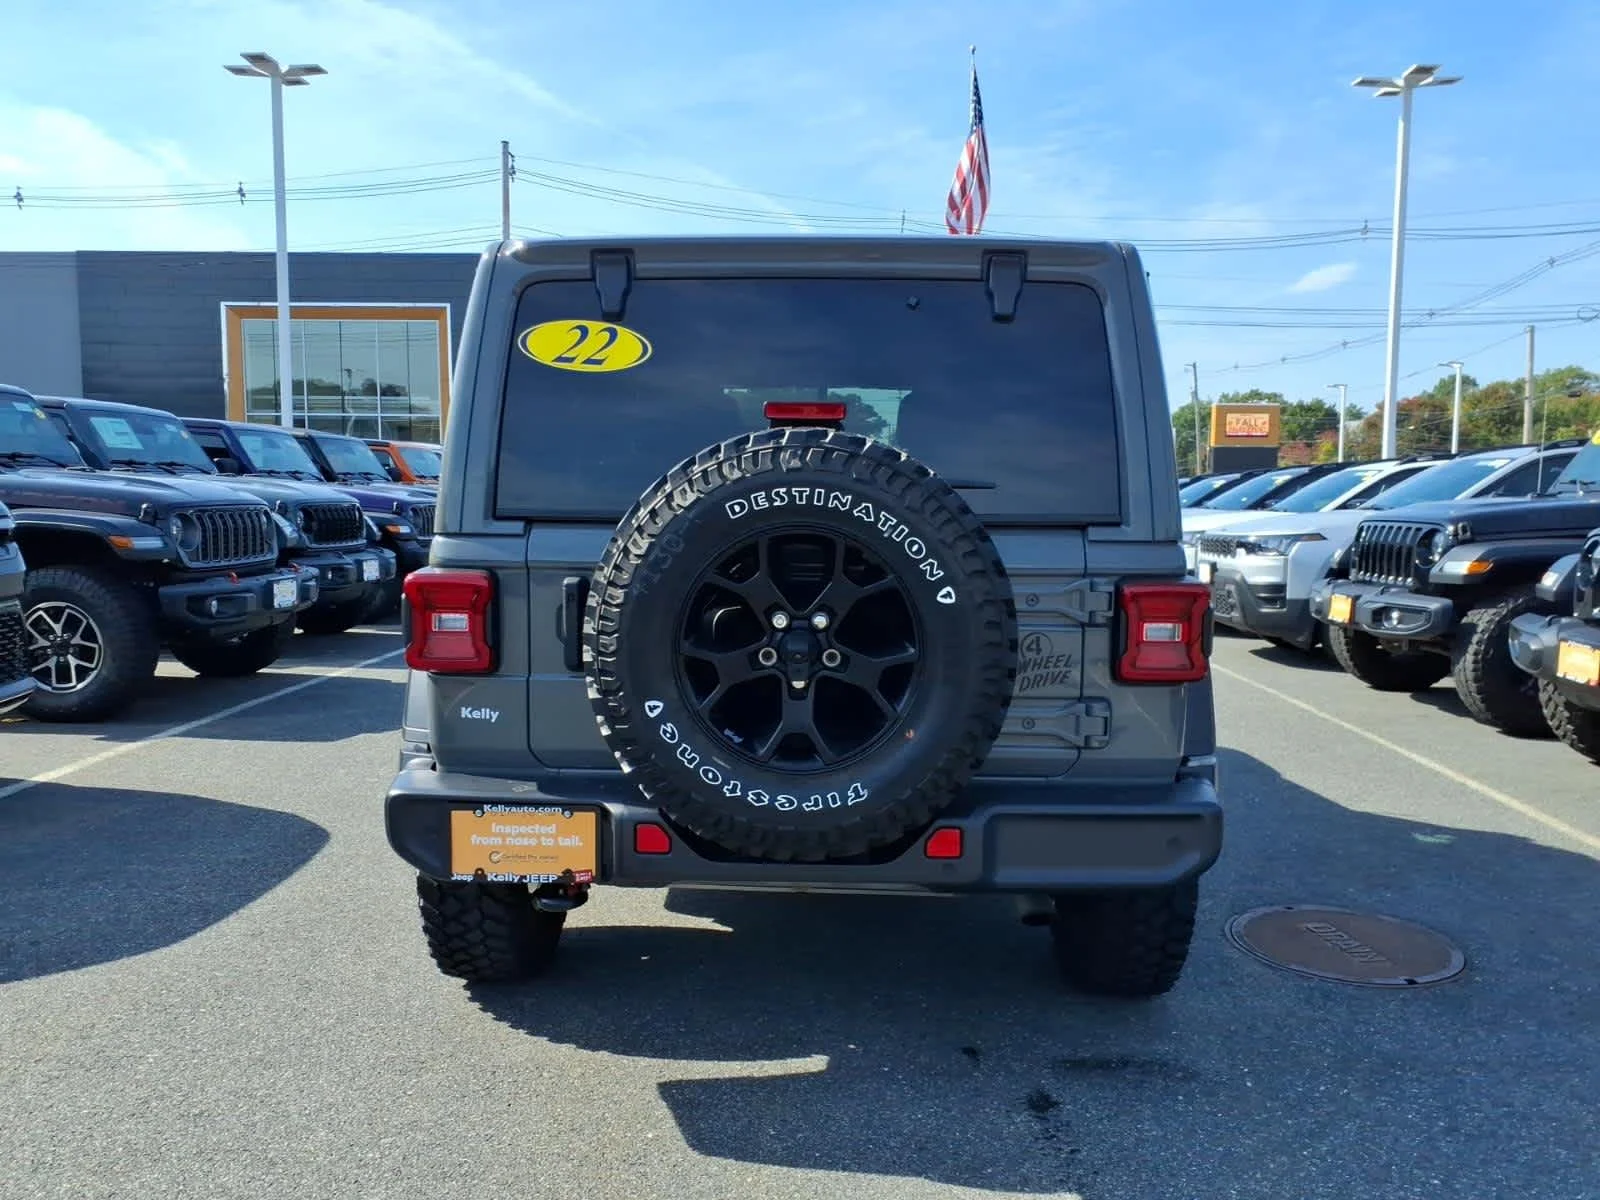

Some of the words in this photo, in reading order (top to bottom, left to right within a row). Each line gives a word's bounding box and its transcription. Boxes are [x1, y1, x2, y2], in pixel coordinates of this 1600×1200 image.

[551, 324, 619, 366] 22
[725, 487, 945, 581] DESTINATION
[1018, 654, 1073, 673] WHEEL
[1019, 670, 1073, 692] DRIVE
[460, 706, 500, 723] Kelly
[483, 804, 563, 815] Kellyauto.com
[491, 822, 557, 836] Inspected
[470, 834, 502, 846] from
[506, 836, 538, 847] nose
[541, 836, 555, 847] to
[558, 835, 584, 847] tail.
[487, 872, 521, 884] Kelly
[522, 873, 558, 884] JEEP
